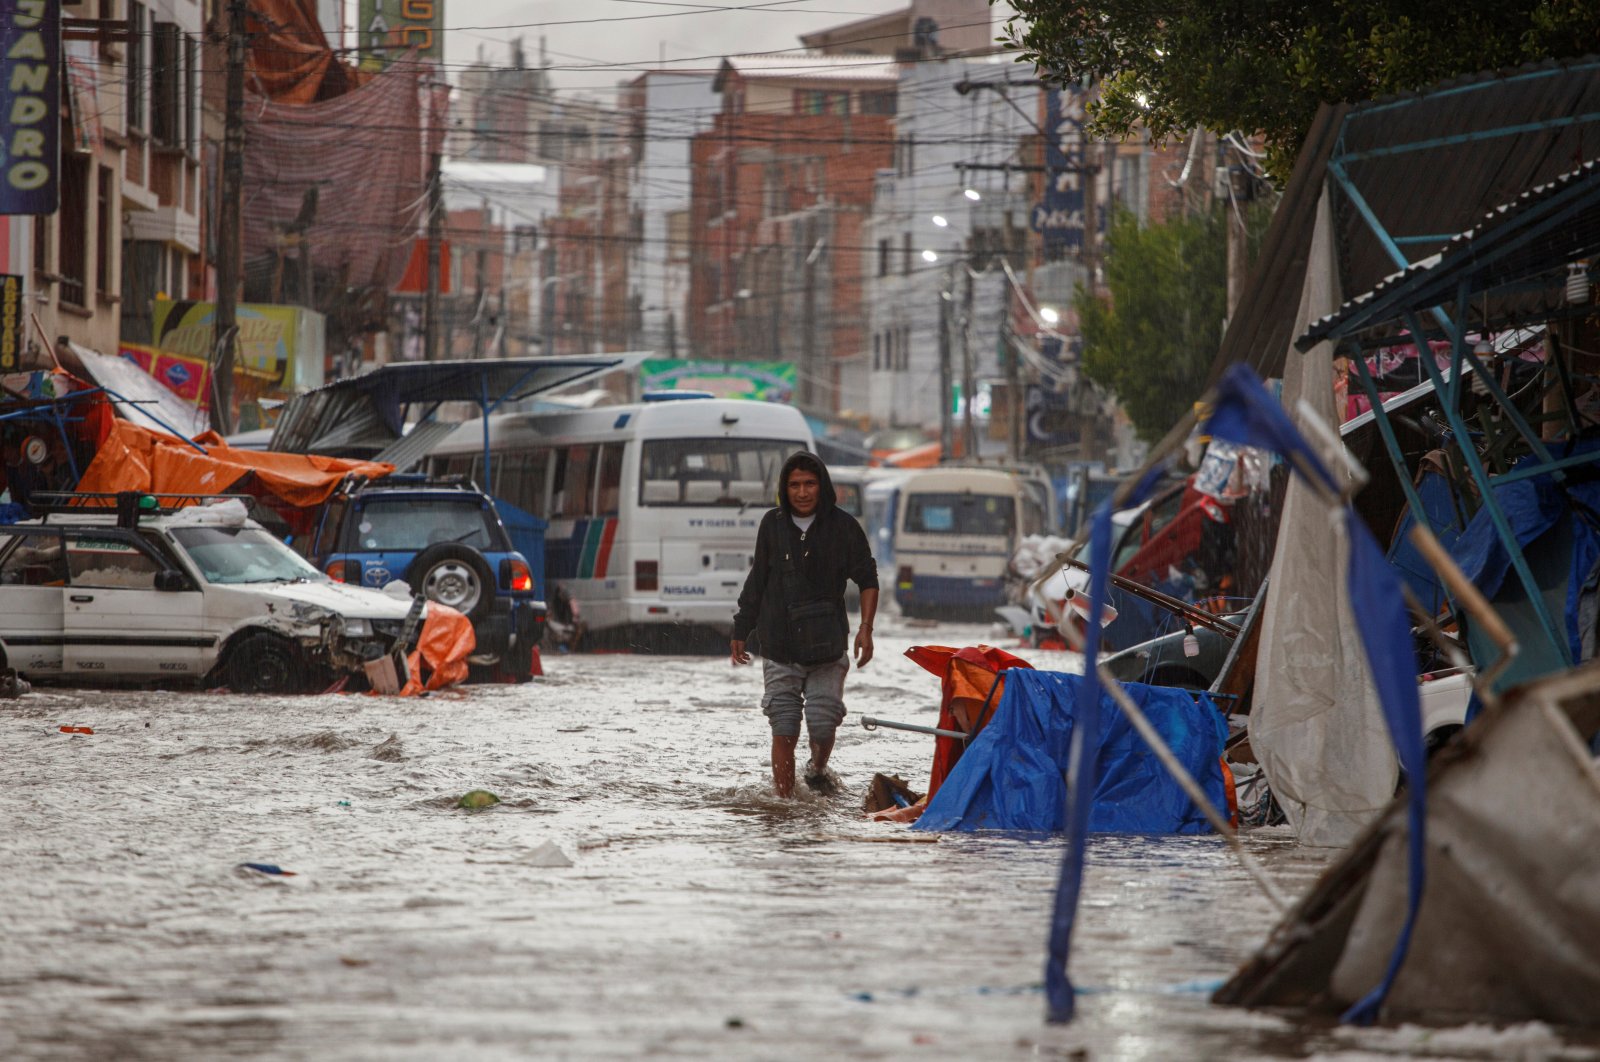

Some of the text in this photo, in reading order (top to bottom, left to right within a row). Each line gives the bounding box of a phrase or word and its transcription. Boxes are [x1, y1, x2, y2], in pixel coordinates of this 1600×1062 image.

[7, 0, 50, 191] JANDRO
[2, 276, 17, 369] ABOGADO
[663, 585, 706, 595] NISSAN
